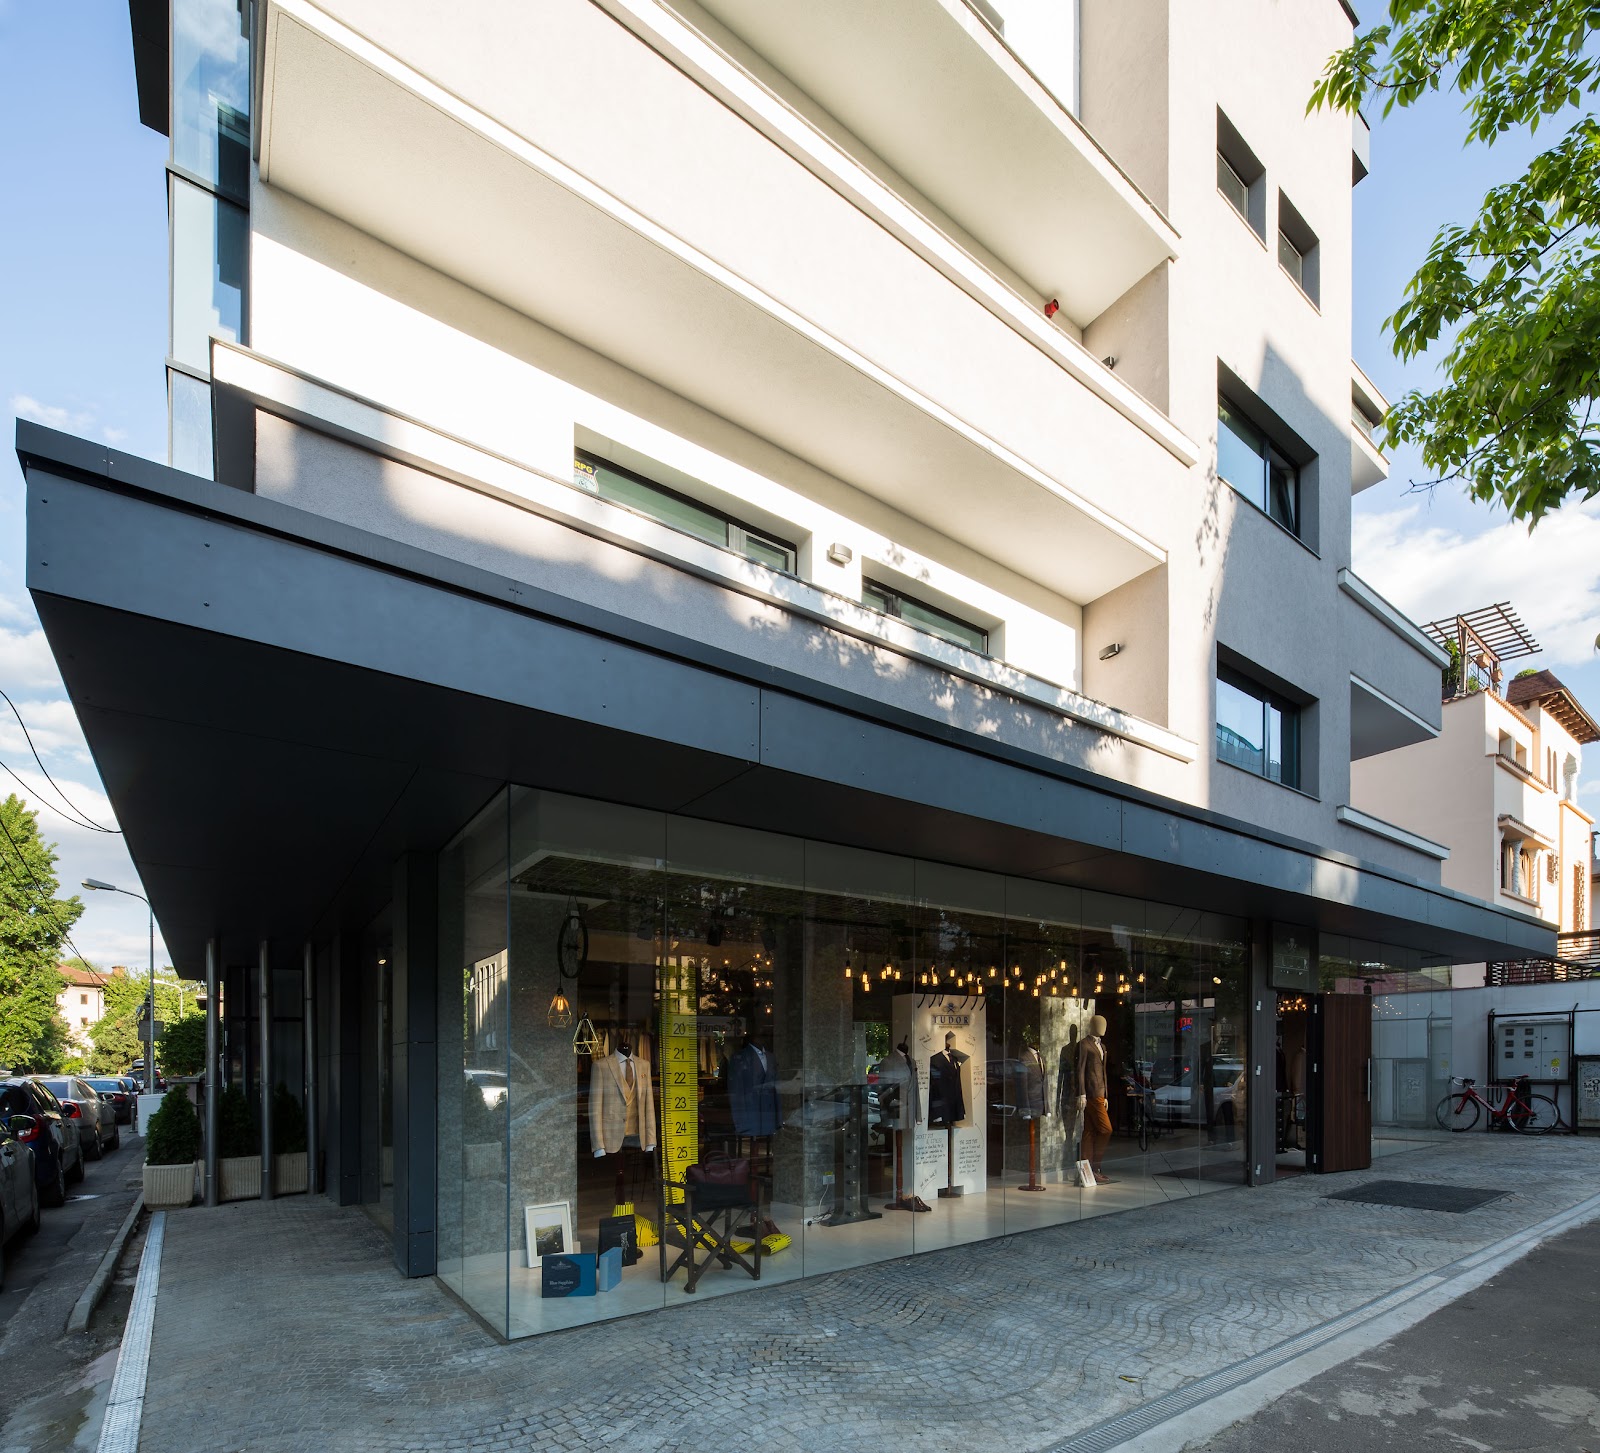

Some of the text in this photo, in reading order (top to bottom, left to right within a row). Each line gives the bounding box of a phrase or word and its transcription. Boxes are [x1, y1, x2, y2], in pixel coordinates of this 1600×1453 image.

[574, 460, 592, 474] RPG
[933, 1015, 969, 1024] TUDOR
[673, 1022, 686, 1035] 20
[673, 1047, 684, 1060] 21
[674, 1072, 687, 1084] 22
[674, 1096, 687, 1109] 23
[675, 1121, 687, 1134] 24
[676, 1146, 688, 1159] 25
